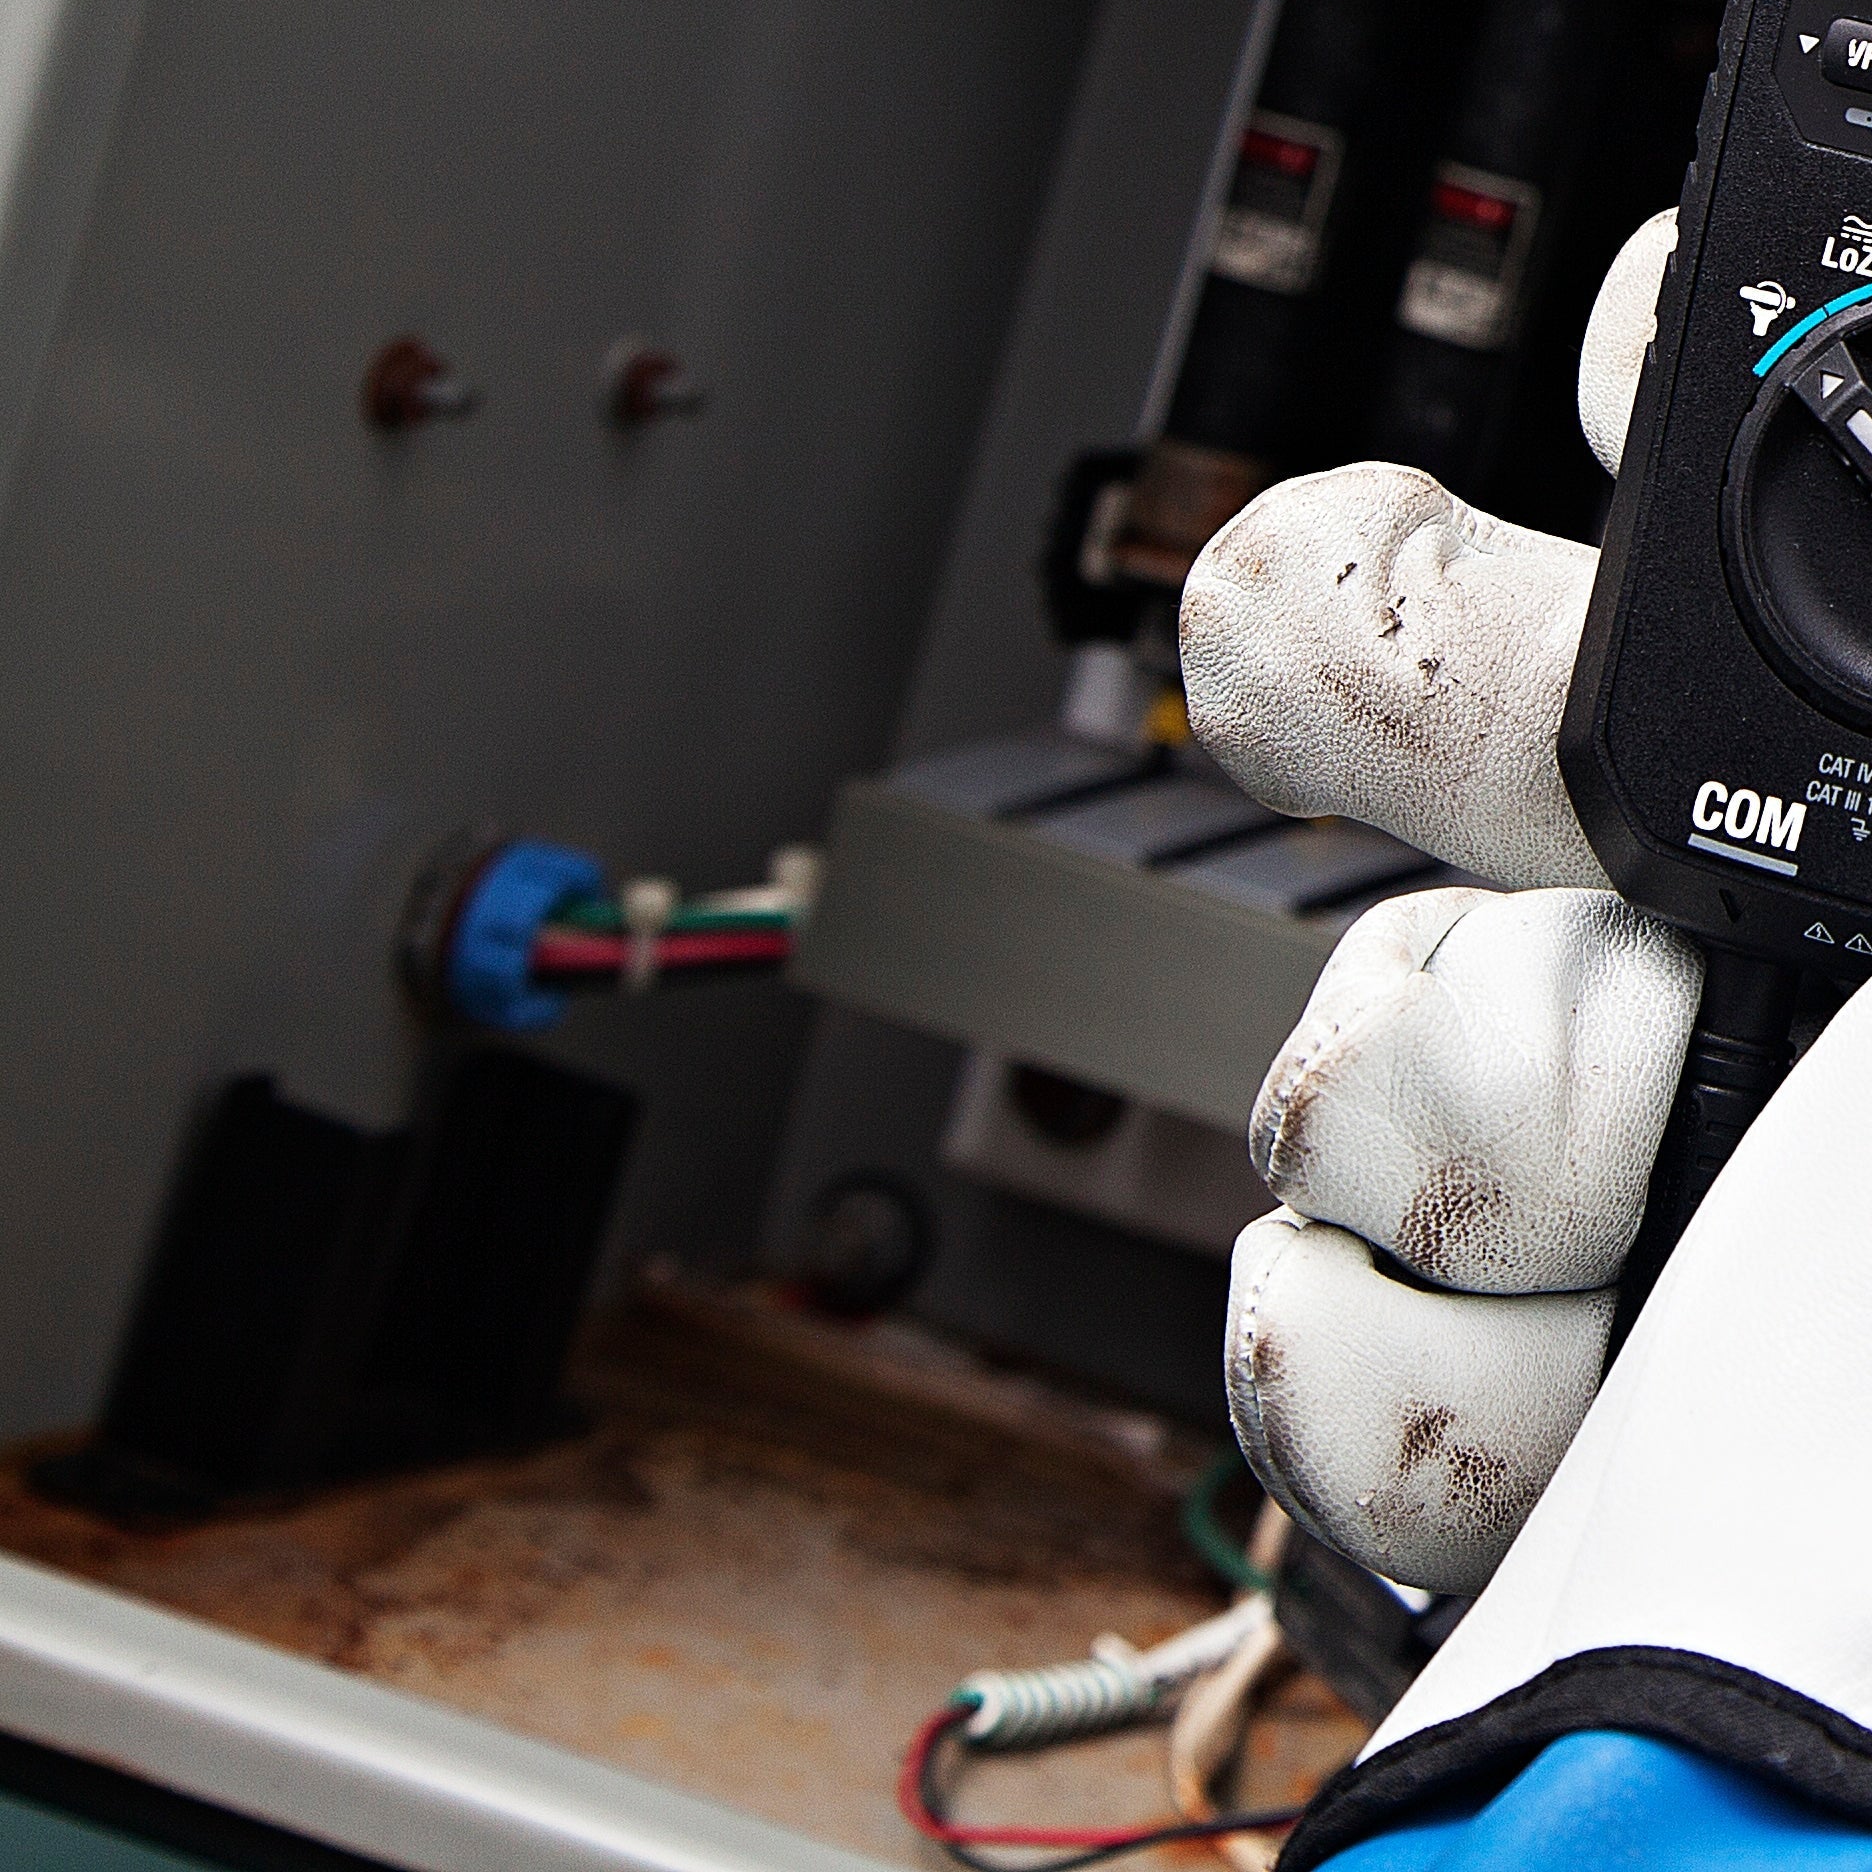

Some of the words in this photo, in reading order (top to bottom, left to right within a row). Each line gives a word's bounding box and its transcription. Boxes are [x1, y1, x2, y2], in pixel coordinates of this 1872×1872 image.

[1818, 753, 1855, 779] CAT
[1806, 780, 1844, 806] CAT
[1844, 790, 1861, 812] III
[1691, 780, 1807, 852] COM
